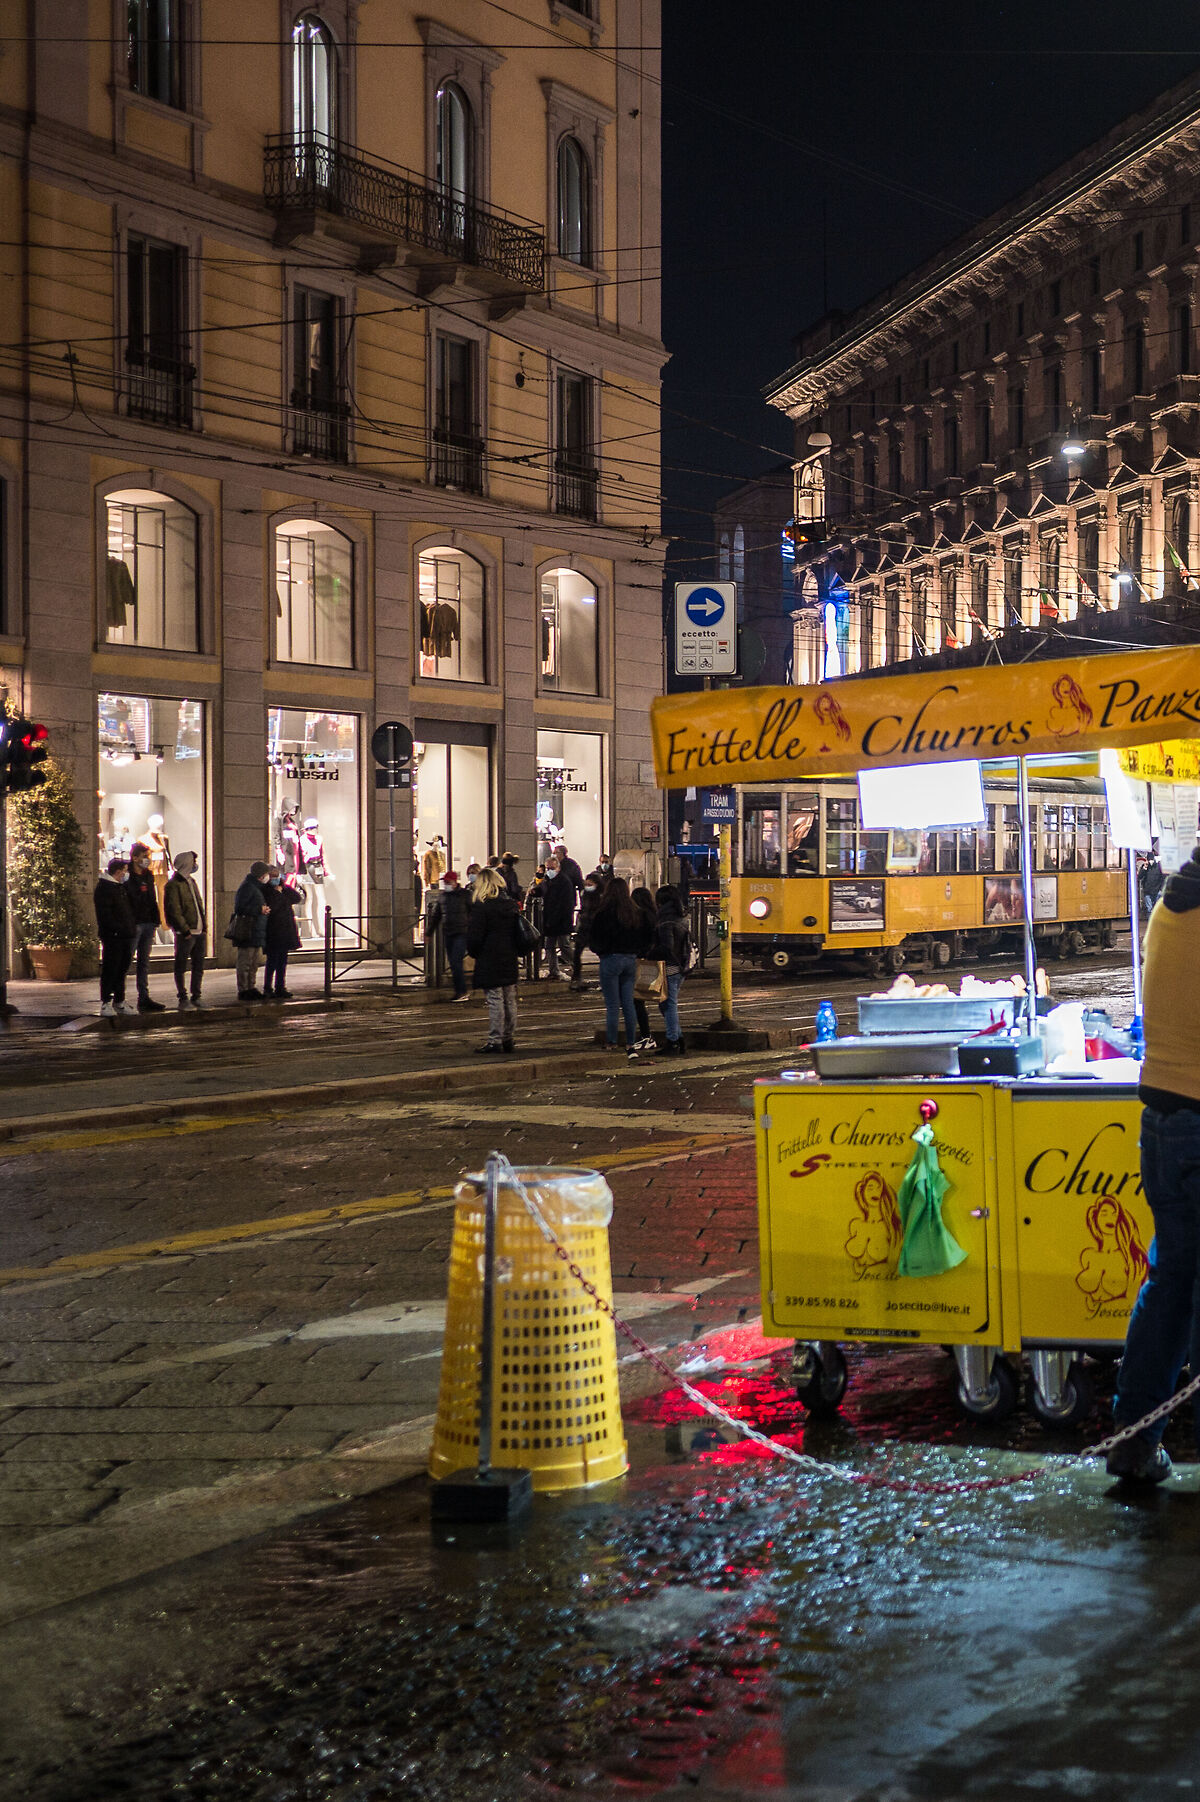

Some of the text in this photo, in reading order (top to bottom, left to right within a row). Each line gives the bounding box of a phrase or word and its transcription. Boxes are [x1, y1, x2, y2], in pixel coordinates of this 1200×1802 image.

[668, 698, 807, 775] Frittelle
[862, 685, 1032, 757] Churros
[710, 794, 728, 807] TRAM
[777, 1118, 822, 1163] Frittelle
[829, 1108, 906, 1147] Churros
[1024, 1122, 1145, 1196] Chur
[885, 1300, 970, 1315] Josecito@live.it
